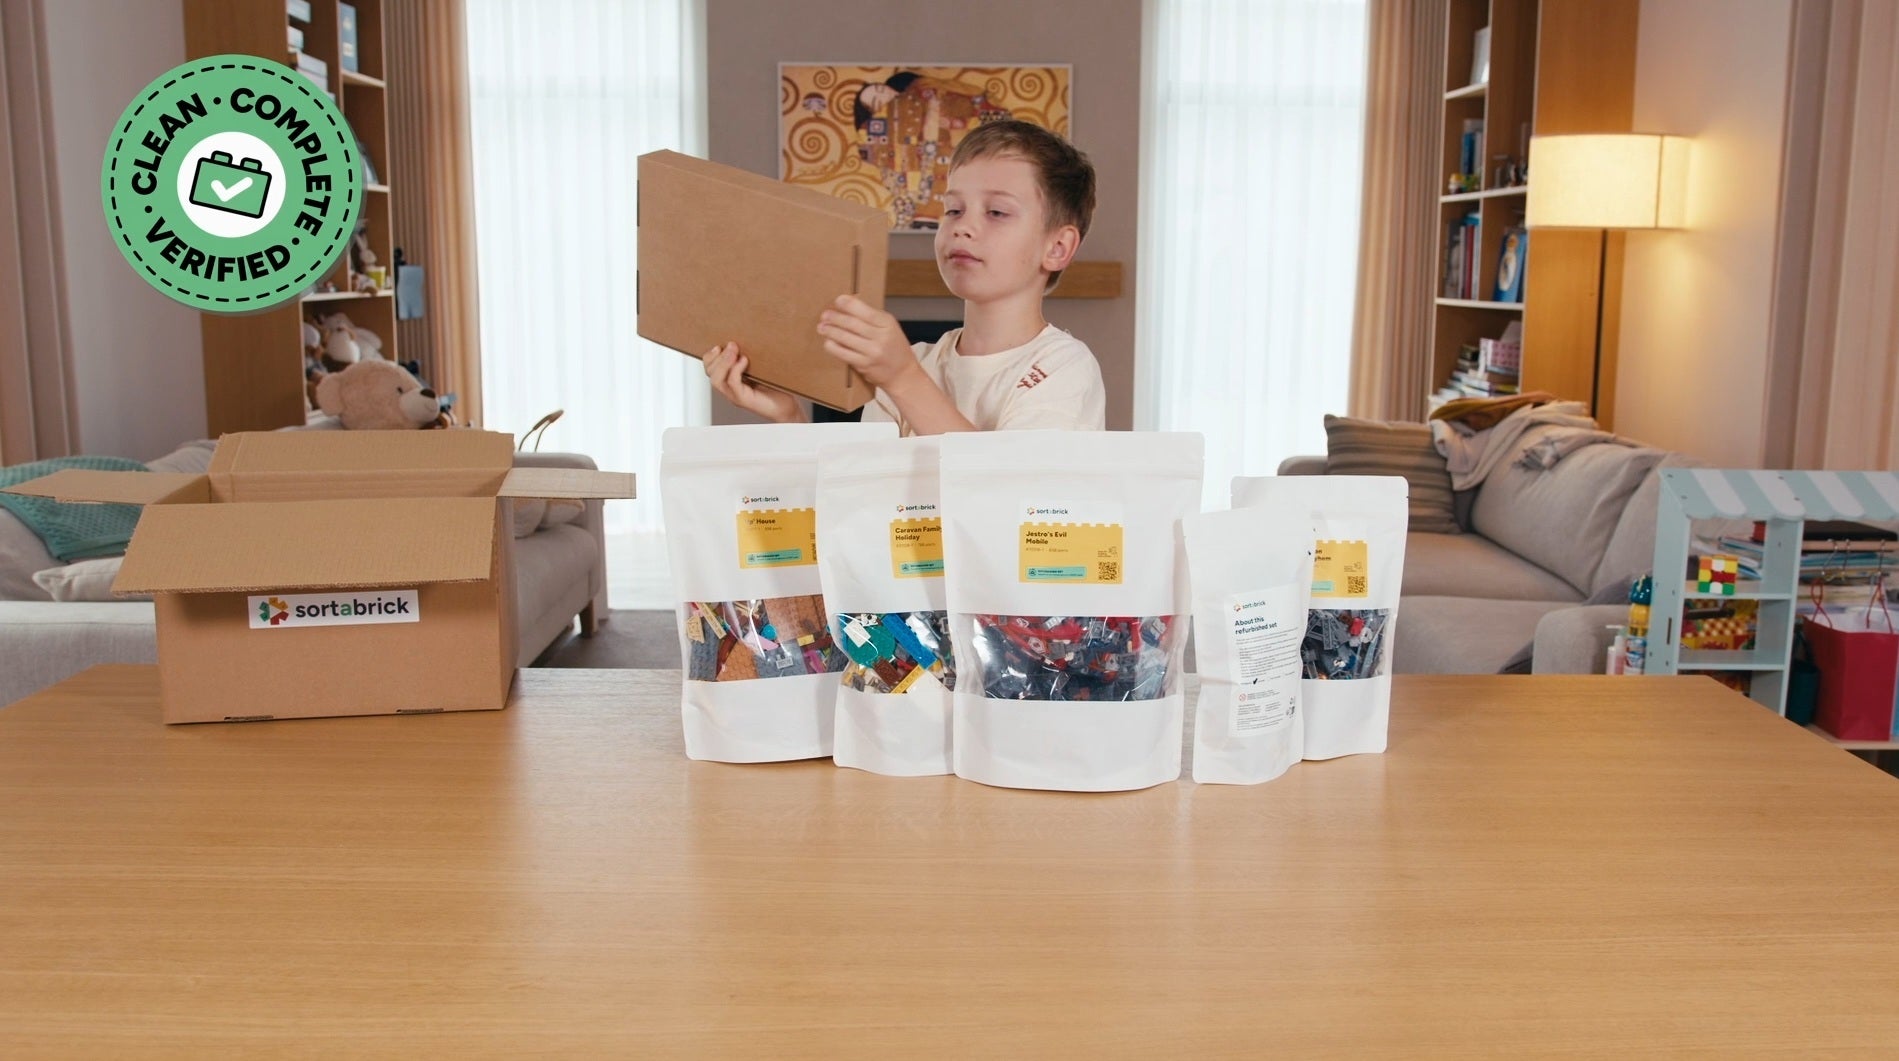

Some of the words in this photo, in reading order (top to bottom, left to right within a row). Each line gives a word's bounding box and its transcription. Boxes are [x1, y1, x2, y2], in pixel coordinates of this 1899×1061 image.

[895, 534, 921, 542] Holiday
[295, 597, 410, 618] sortabrick
[1235, 623, 1269, 635] refurbished
[1269, 621, 1278, 629] set
